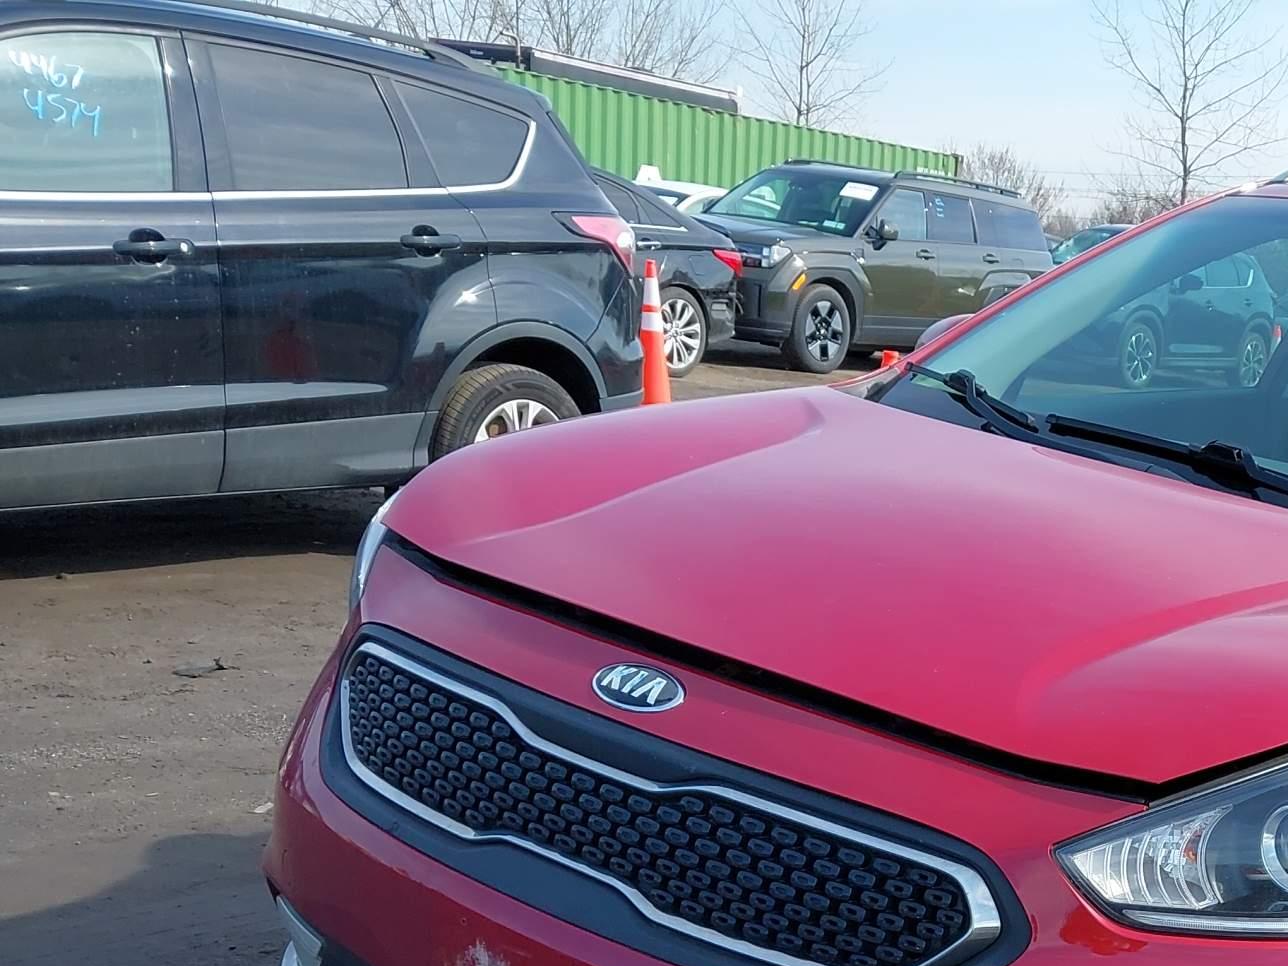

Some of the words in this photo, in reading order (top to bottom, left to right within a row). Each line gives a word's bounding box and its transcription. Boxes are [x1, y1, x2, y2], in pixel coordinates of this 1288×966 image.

[8, 50, 84, 90] 4467
[23, 88, 100, 137] 4574
[600, 665, 668, 705] KIA
